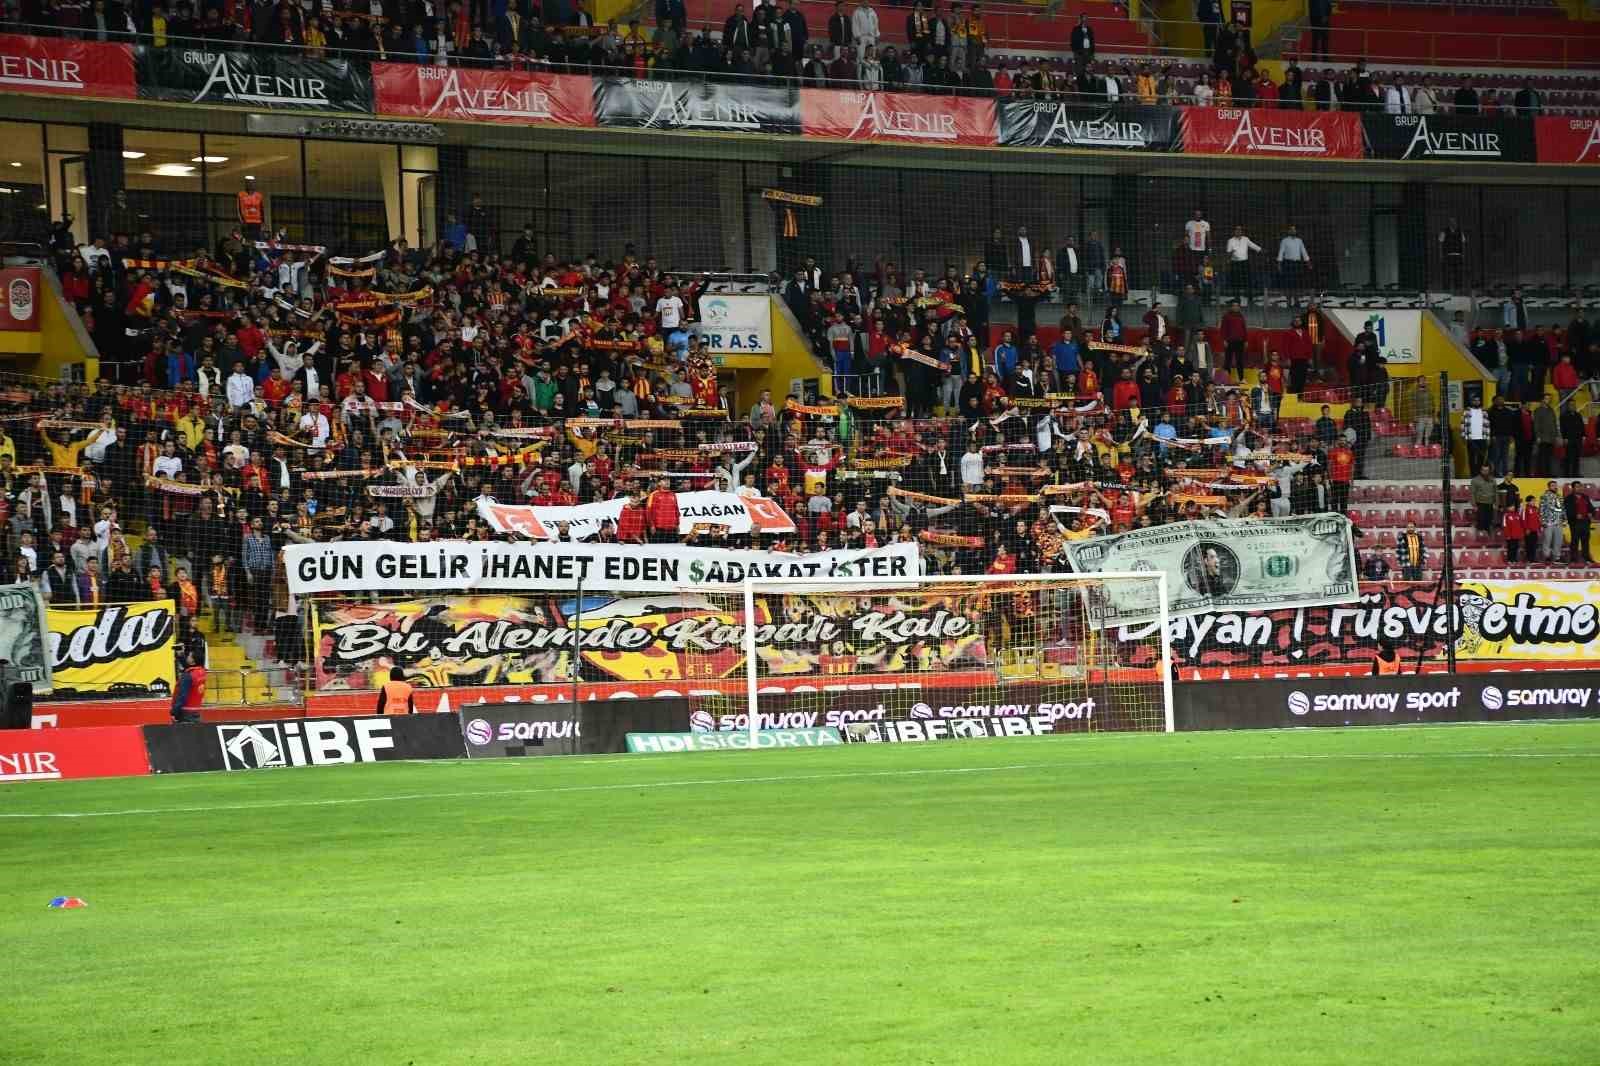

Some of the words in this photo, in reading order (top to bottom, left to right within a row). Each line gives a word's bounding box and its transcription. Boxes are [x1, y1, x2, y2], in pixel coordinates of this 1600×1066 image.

[183, 51, 215, 65] GRUP
[193, 53, 328, 103] AVENIR
[427, 69, 550, 117] AVENIR
[642, 82, 759, 129] AVENIR
[847, 93, 957, 139] AVENIR
[1032, 102, 1057, 114] GRUP
[1218, 109, 1242, 120] GRUP
[1395, 116, 1418, 127] GRUP
[1040, 103, 1144, 147] AVENIR
[1224, 110, 1325, 154] AVENIR
[1401, 116, 1501, 160] AVENIR
[1570, 119, 1593, 130] GRUP
[298, 551, 363, 581] GÜN
[375, 548, 471, 579] GELİR
[481, 548, 594, 579] İHANET
[604, 556, 680, 582] EDEN
[852, 609, 971, 643] Kale
[1330, 593, 1460, 641] rüsva
[1483, 591, 1597, 637] etme
[1037, 697, 1096, 723] sport
[1313, 692, 1400, 712] samuray
[1406, 686, 1461, 712] sport
[1506, 686, 1592, 707] samuray
